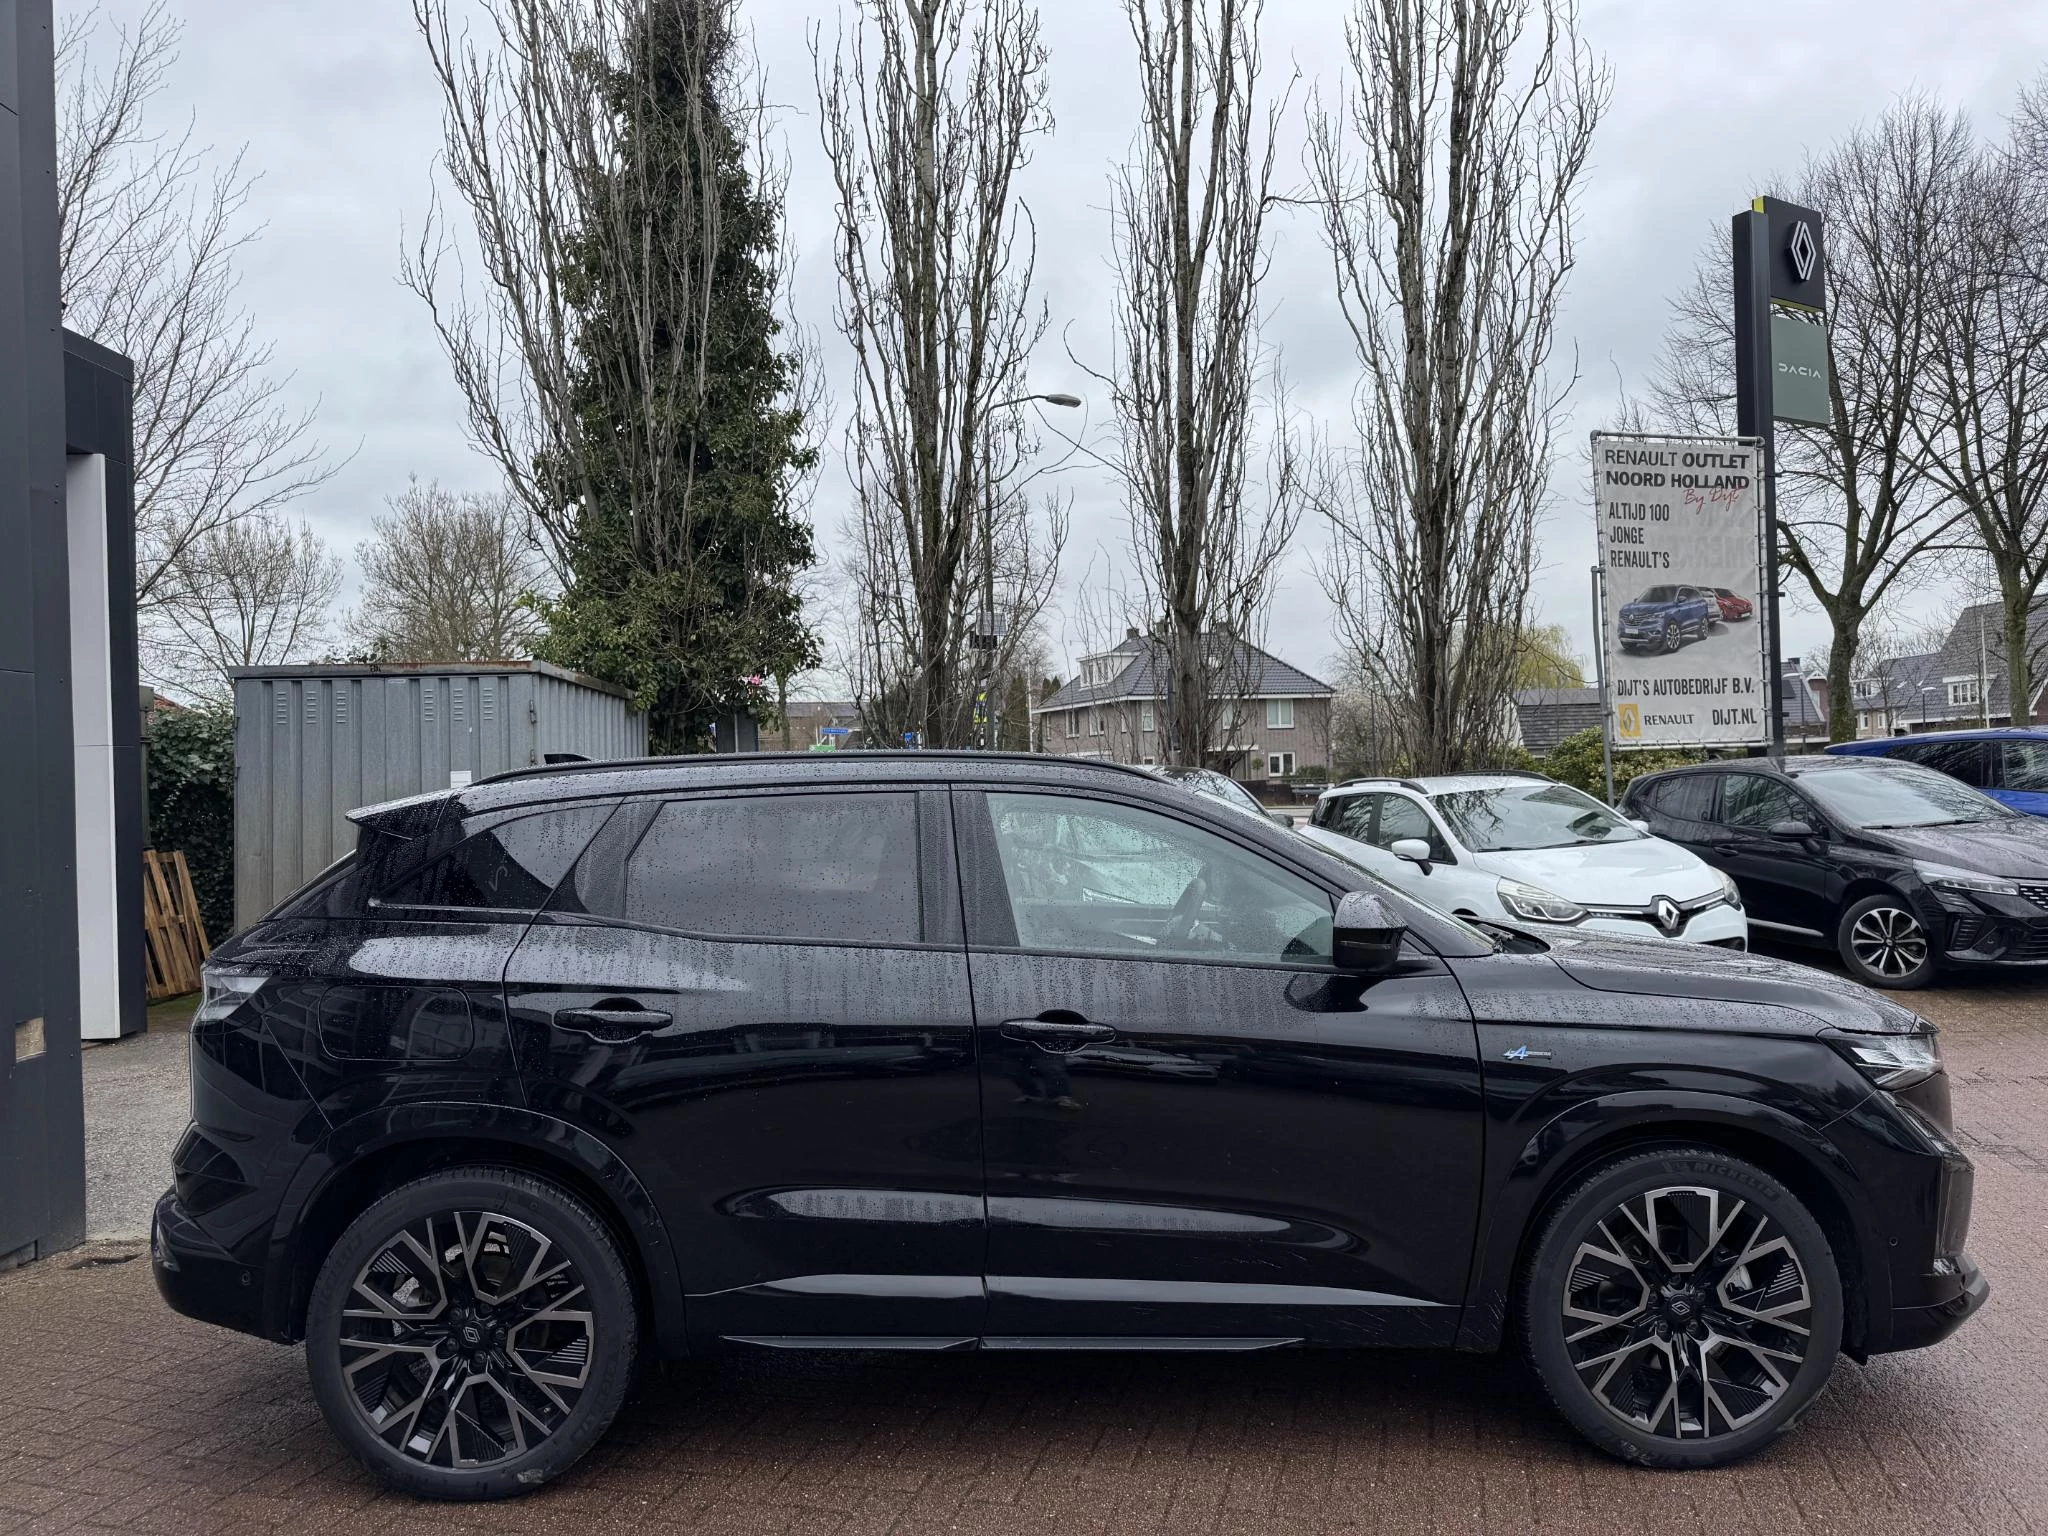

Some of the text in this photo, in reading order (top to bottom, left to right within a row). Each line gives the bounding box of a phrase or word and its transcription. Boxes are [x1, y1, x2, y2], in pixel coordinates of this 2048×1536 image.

[1778, 362, 1821, 379] DACIA
[1605, 450, 1749, 469] RENAULT OUTLET
[1606, 471, 1749, 489] NOORD HOLLAND
[1684, 488, 1705, 515] By
[1608, 502, 1669, 521] ALTIJD 100
[1610, 526, 1644, 544] JONGE
[1610, 550, 1670, 569] RENAULT'S
[1617, 677, 1755, 696] DIJT'S AUTOBEDRIJF B.V.
[1644, 708, 1758, 726] RENAULT DIJT.NL
